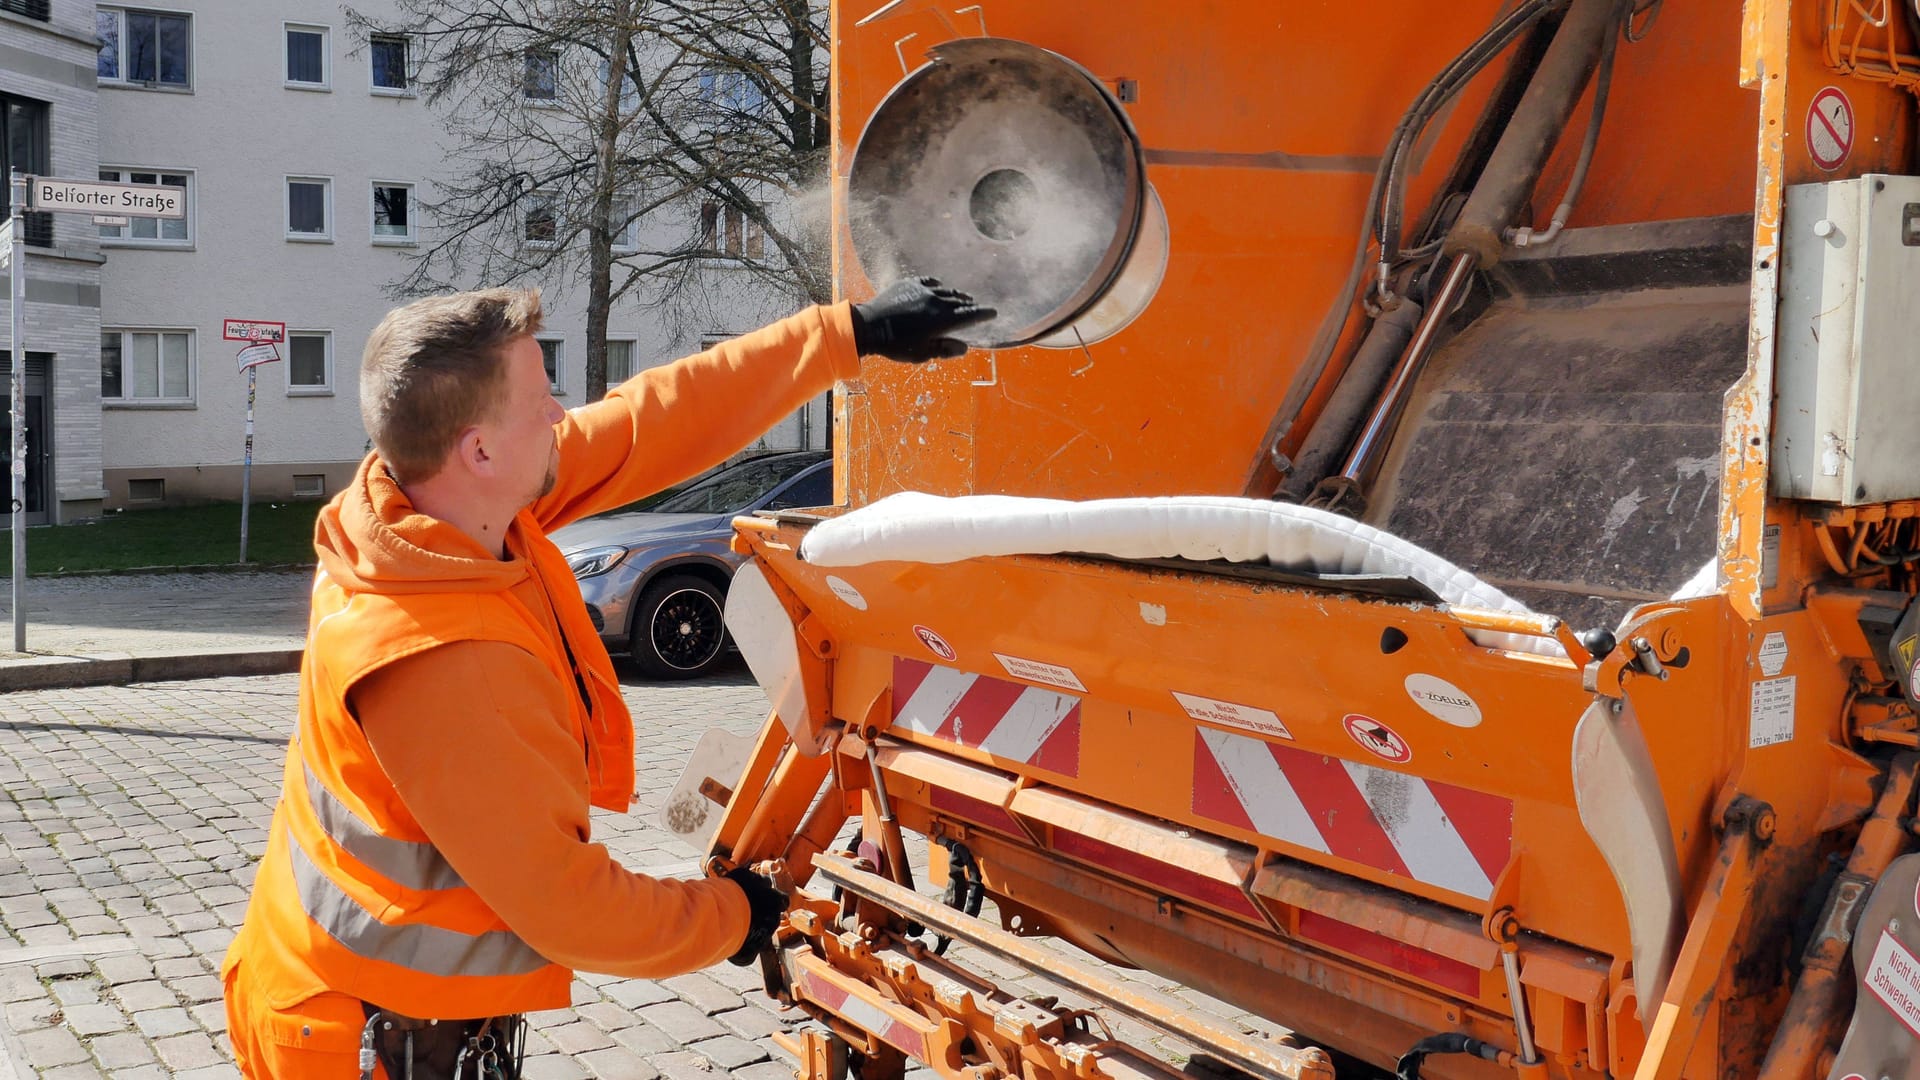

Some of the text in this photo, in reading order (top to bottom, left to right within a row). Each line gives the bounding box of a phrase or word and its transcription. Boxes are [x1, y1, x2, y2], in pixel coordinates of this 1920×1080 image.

[43, 186, 175, 213] Belforter Straße
[1213, 703, 1240, 716] Nicht
[1425, 692, 1473, 708] ZOELLER
[1888, 950, 1912, 981] Nicht
[1874, 966, 1920, 1024] Schwenkarm
